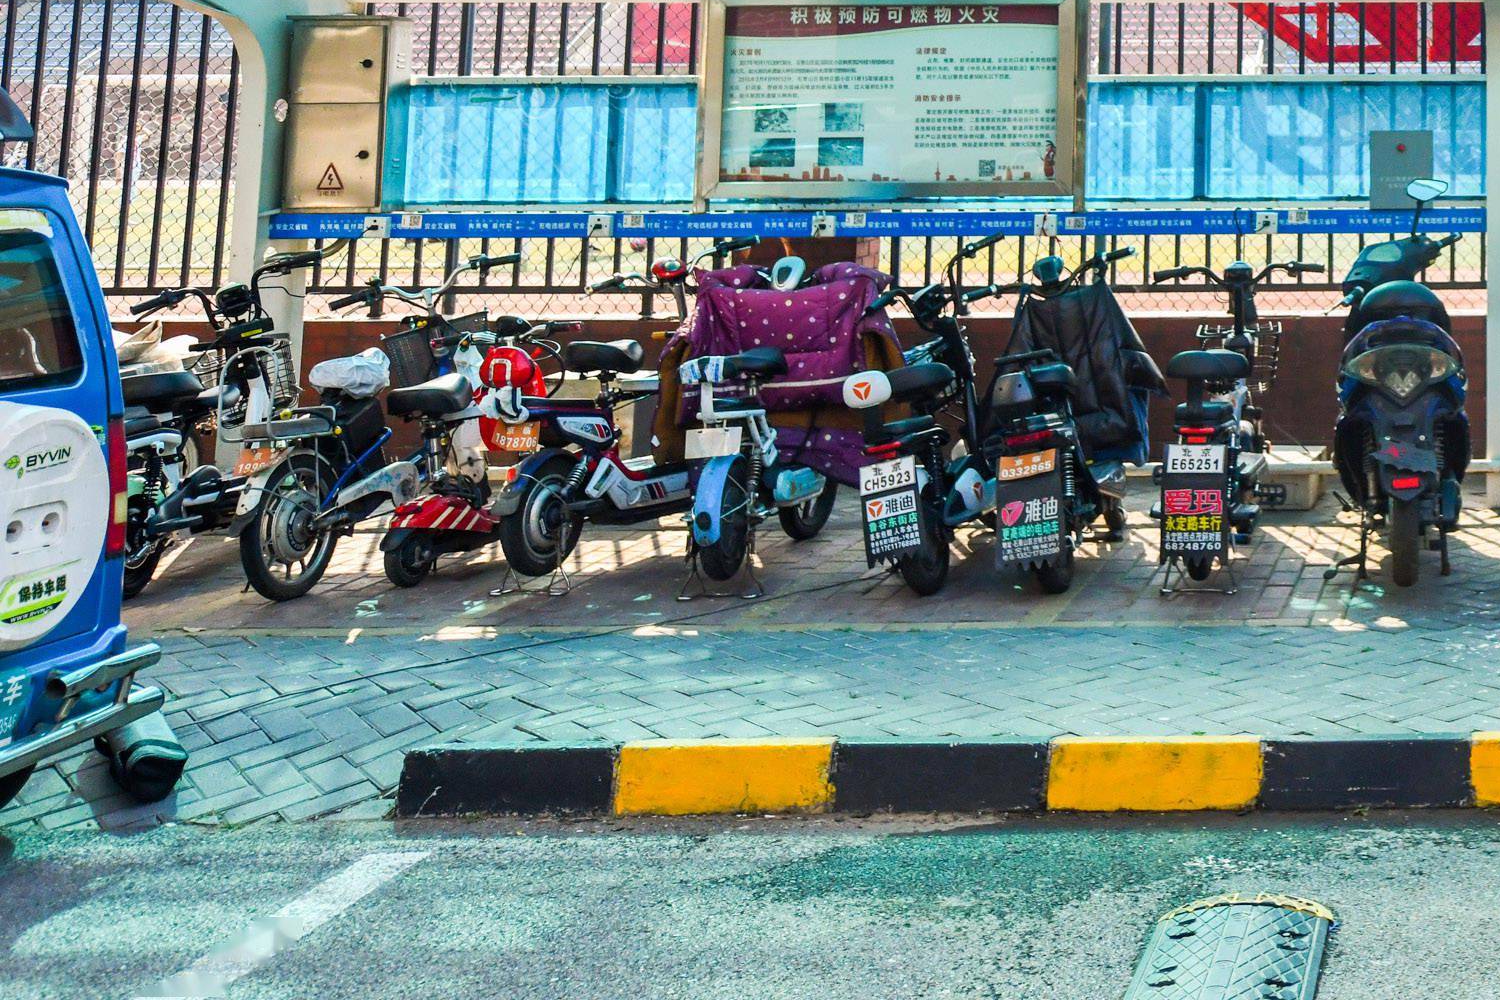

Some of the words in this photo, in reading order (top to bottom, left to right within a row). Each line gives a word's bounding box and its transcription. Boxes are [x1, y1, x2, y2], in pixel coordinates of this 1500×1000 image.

[790, 6, 1000, 25] 积极预防可燃物火灾
[26, 446, 72, 468] BYVIN
[1171, 458, 1219, 471] E65251
[864, 470, 911, 491] CH5923
[885, 495, 915, 515] 雅迪
[1024, 496, 1059, 524] 雅迪
[1164, 489, 1223, 515] 爱玛
[1165, 515, 1222, 532] 永定路车行
[1165, 542, 1222, 551] 68248760
[18, 574, 68, 604] 保持车距
